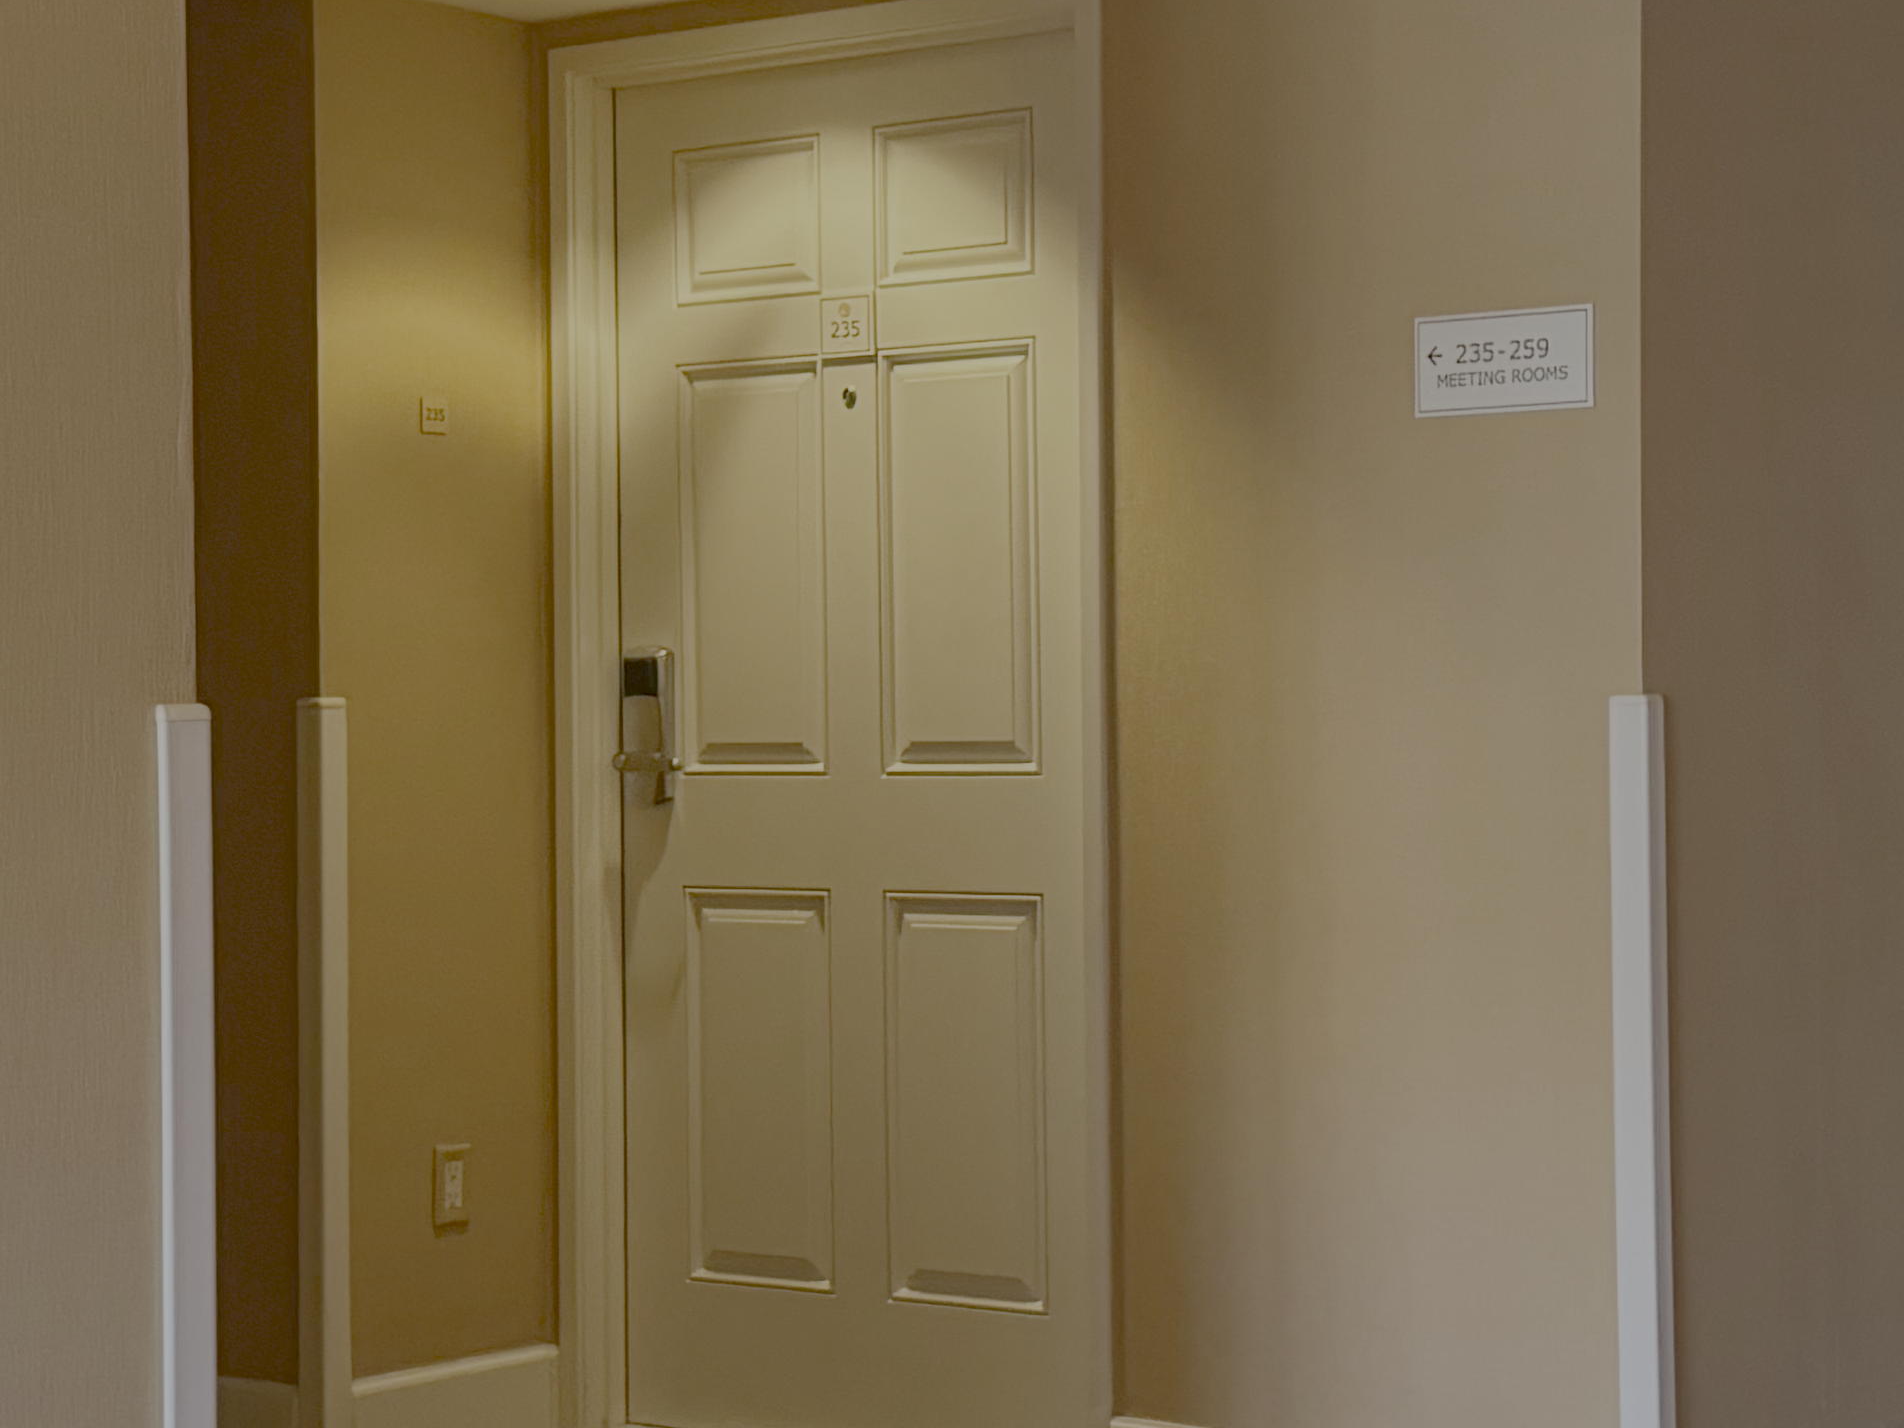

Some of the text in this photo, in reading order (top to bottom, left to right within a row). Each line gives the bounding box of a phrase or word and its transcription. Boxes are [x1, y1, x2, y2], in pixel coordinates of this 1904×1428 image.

[831, 320, 860, 339] 235
[1455, 338, 1550, 365] 235-259
[1436, 365, 1569, 389] MEETING ROOMS
[425, 407, 445, 422] 235
